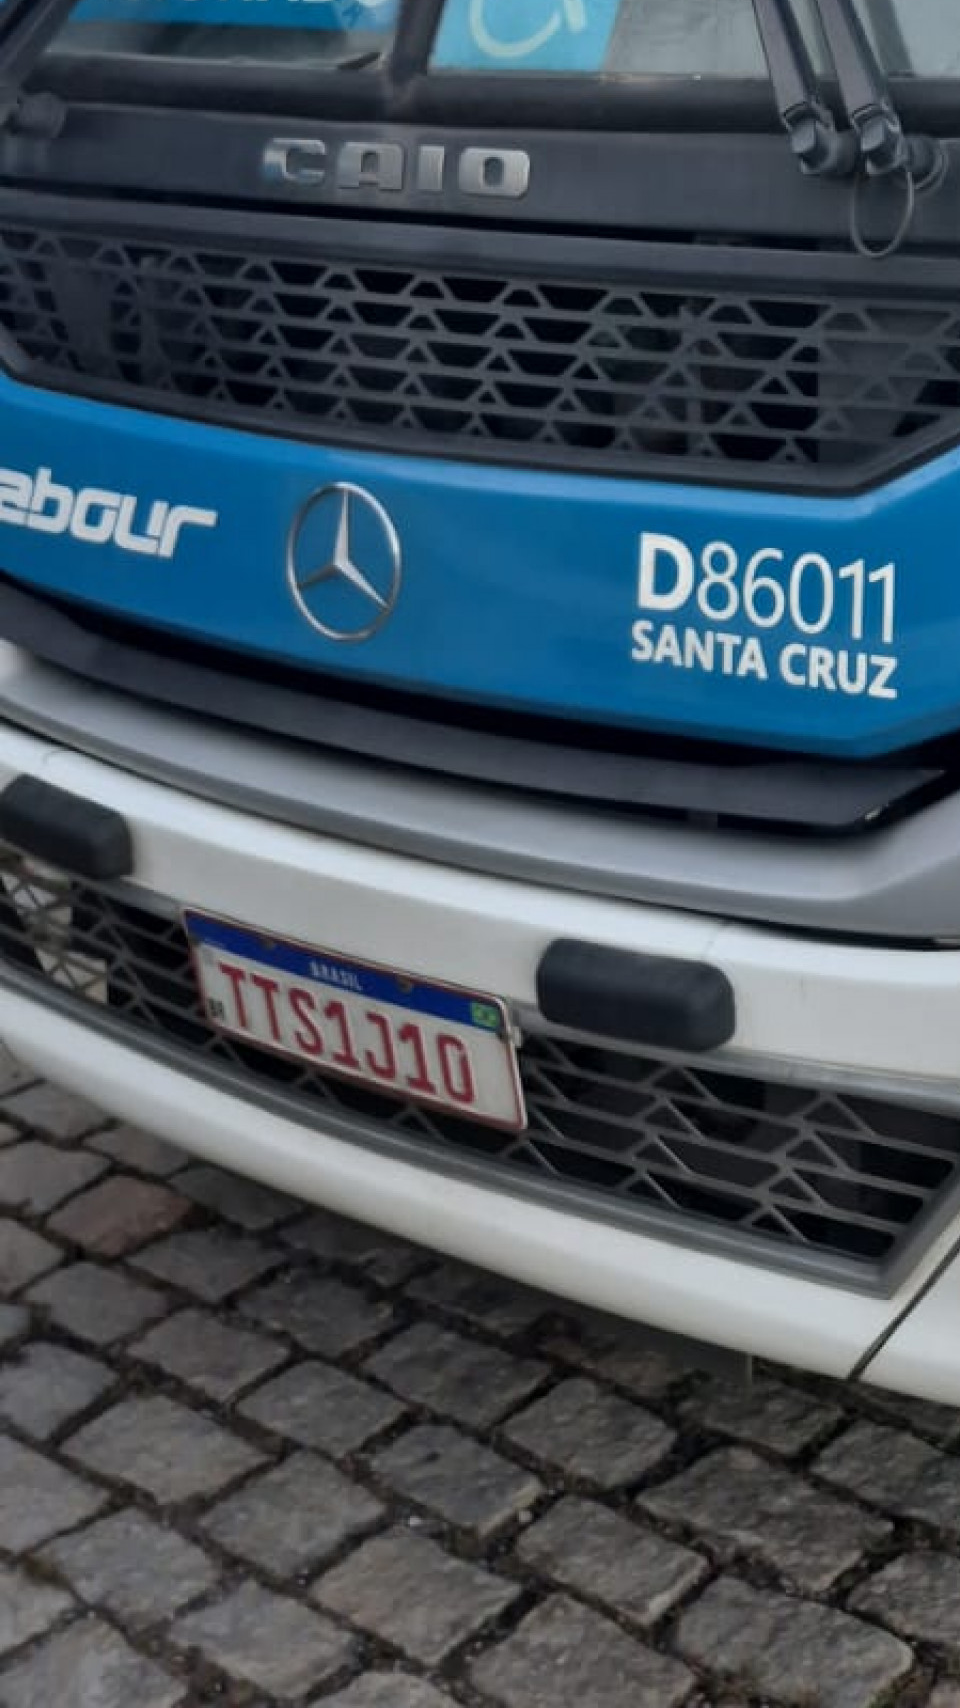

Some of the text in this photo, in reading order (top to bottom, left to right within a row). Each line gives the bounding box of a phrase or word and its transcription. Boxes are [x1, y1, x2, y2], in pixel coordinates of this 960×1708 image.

[263, 138, 531, 198] CAIO
[0, 466, 218, 559] abour
[637, 531, 896, 644] D86011
[630, 620, 898, 700] SANTA CRUZ
[308, 960, 364, 992] BRASIL
[219, 961, 475, 1104] TTS1J10
